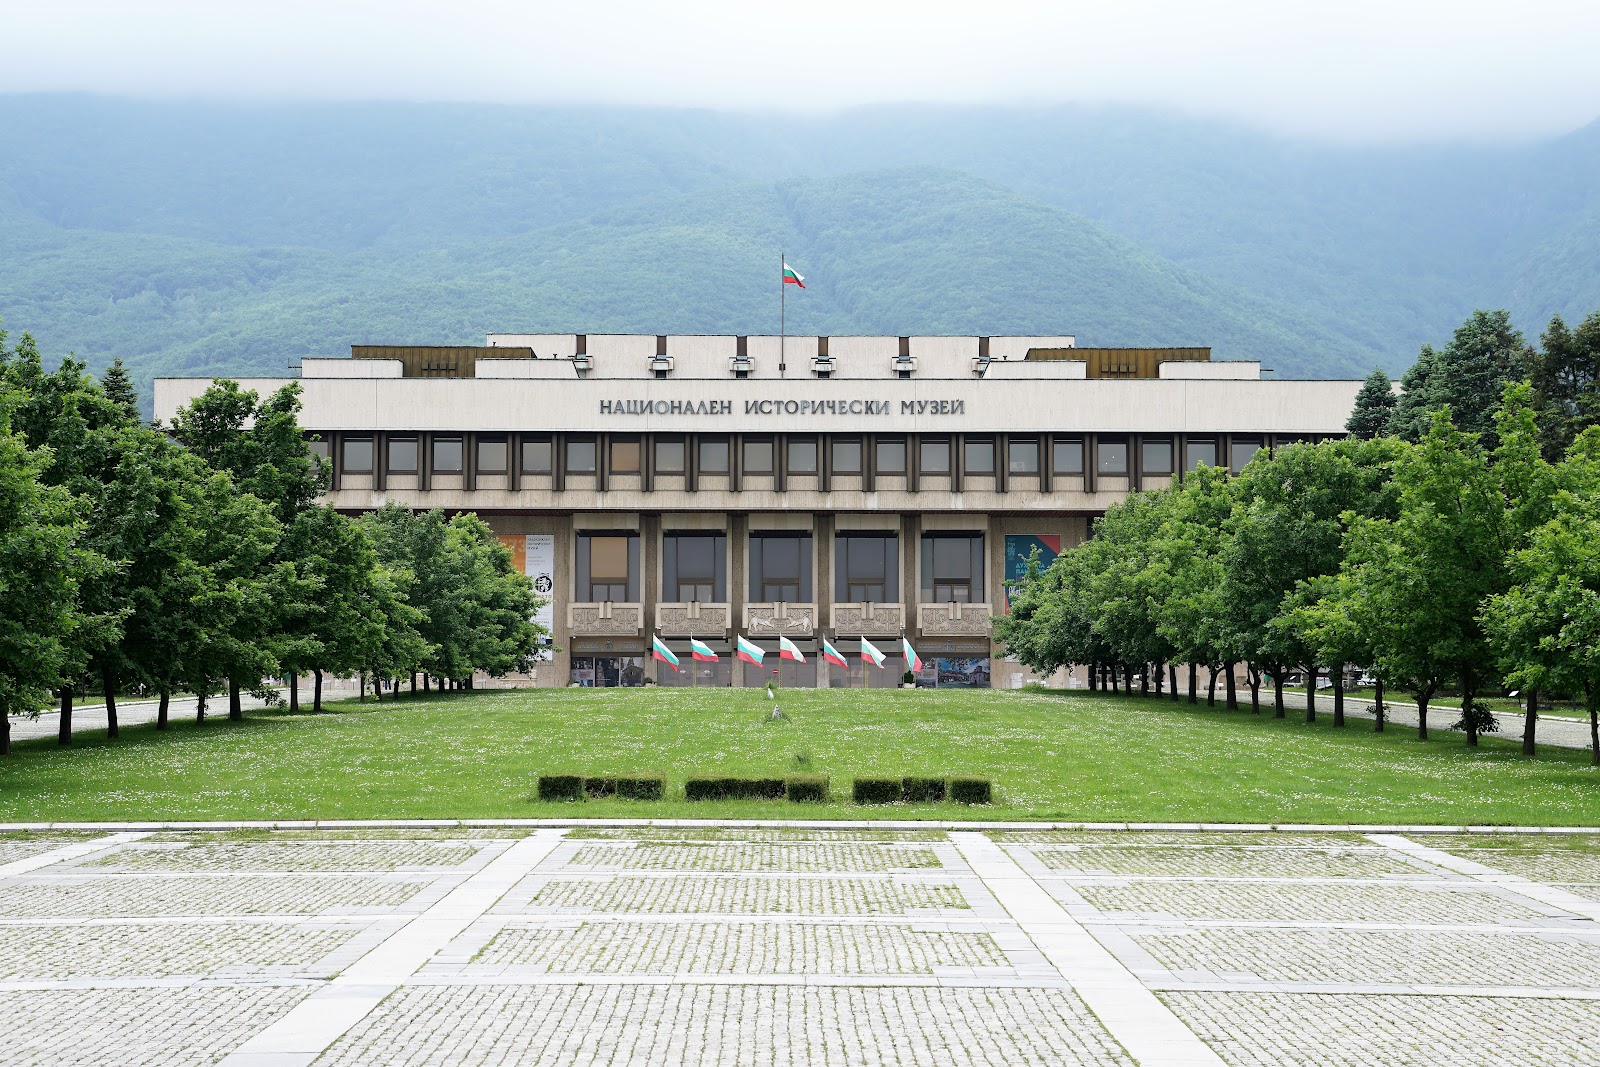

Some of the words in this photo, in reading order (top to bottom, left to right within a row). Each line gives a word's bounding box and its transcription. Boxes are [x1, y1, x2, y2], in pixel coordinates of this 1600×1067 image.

[600, 400, 732, 416] НАЦИОНАЛЕН
[745, 400, 889, 415] ИСТОРИЧЕСКИ
[901, 399, 964, 415] МУЗЕЙ
